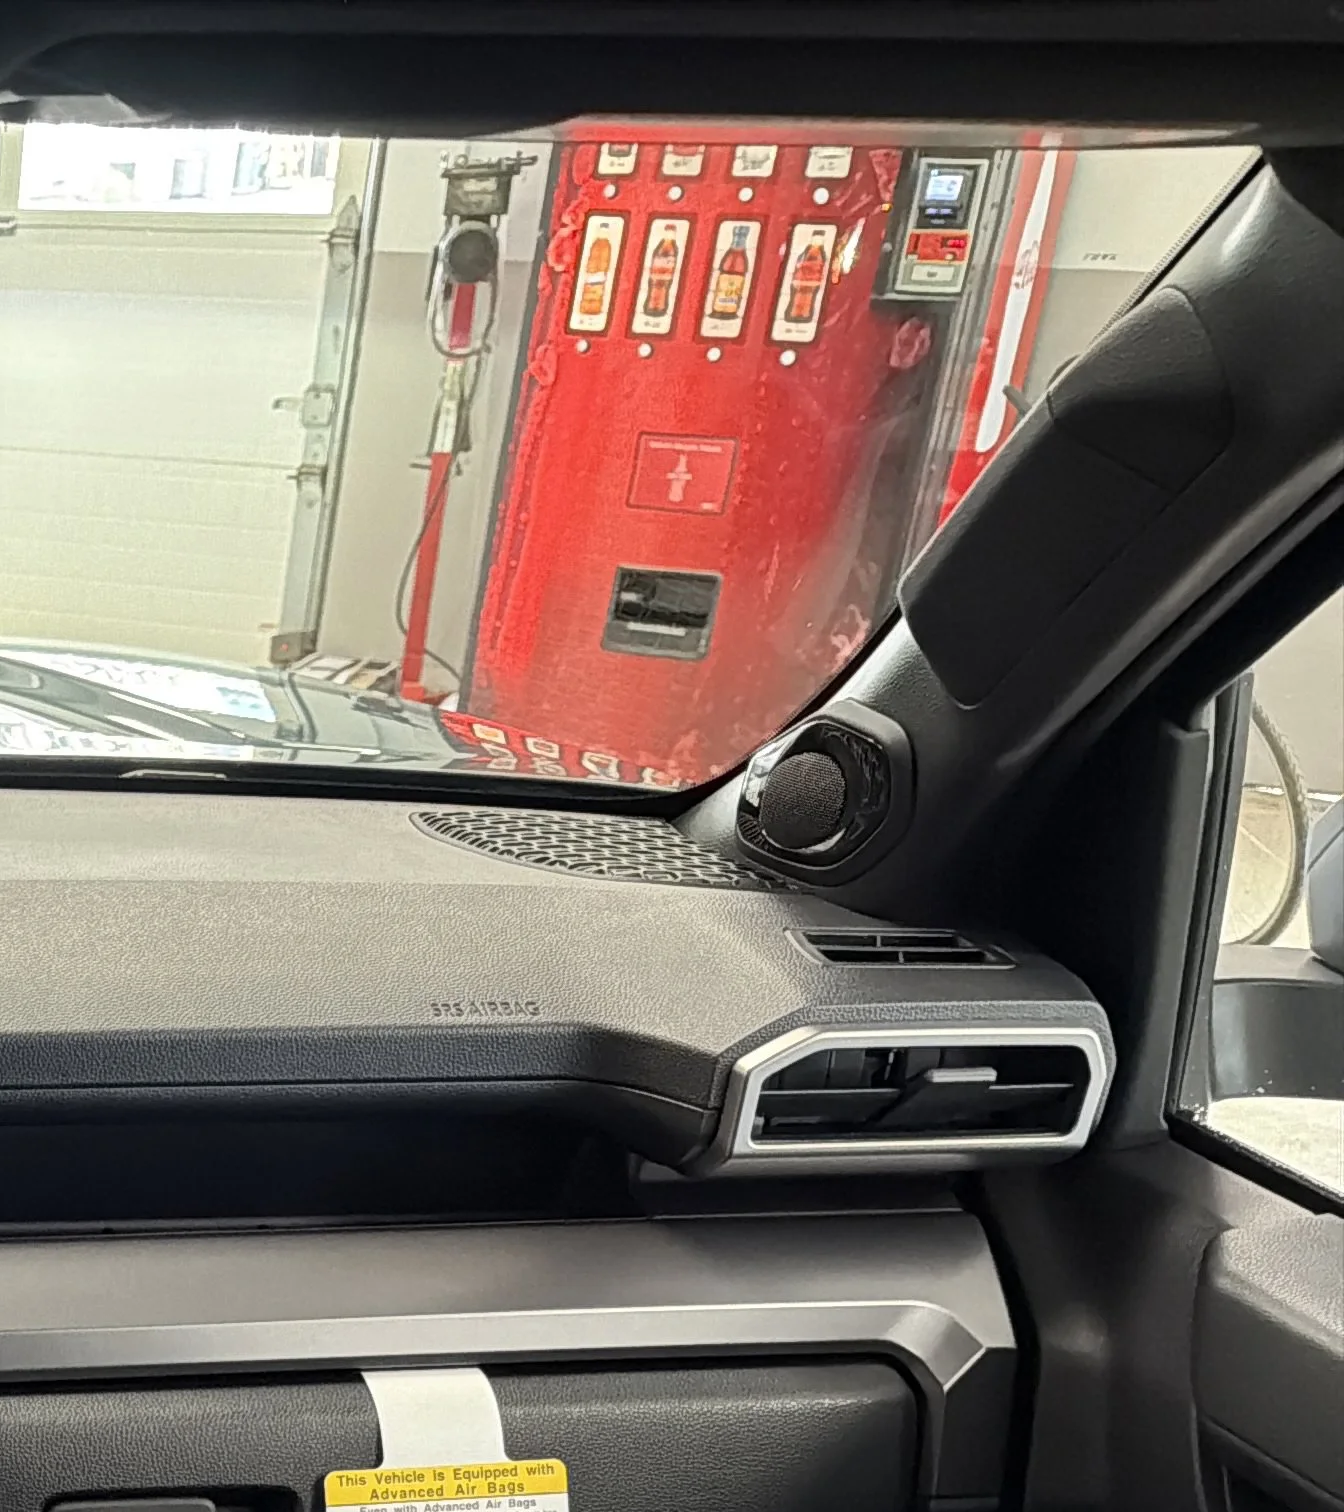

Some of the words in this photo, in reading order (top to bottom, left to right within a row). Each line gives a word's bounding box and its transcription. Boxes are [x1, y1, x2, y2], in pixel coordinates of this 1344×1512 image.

[469, 1001, 540, 1017] AIRBAG
[336, 1474, 367, 1487] This
[374, 1470, 425, 1485] Vehicle
[454, 1465, 518, 1482] Equipped
[526, 1463, 555, 1476] with
[370, 1485, 444, 1501] Advanced
[455, 1483, 477, 1496] Air
[488, 1481, 525, 1495] Bags
[424, 1501, 479, 1512] Advanced
[486, 1499, 502, 1509] Air
[508, 1498, 537, 1510] Bags
